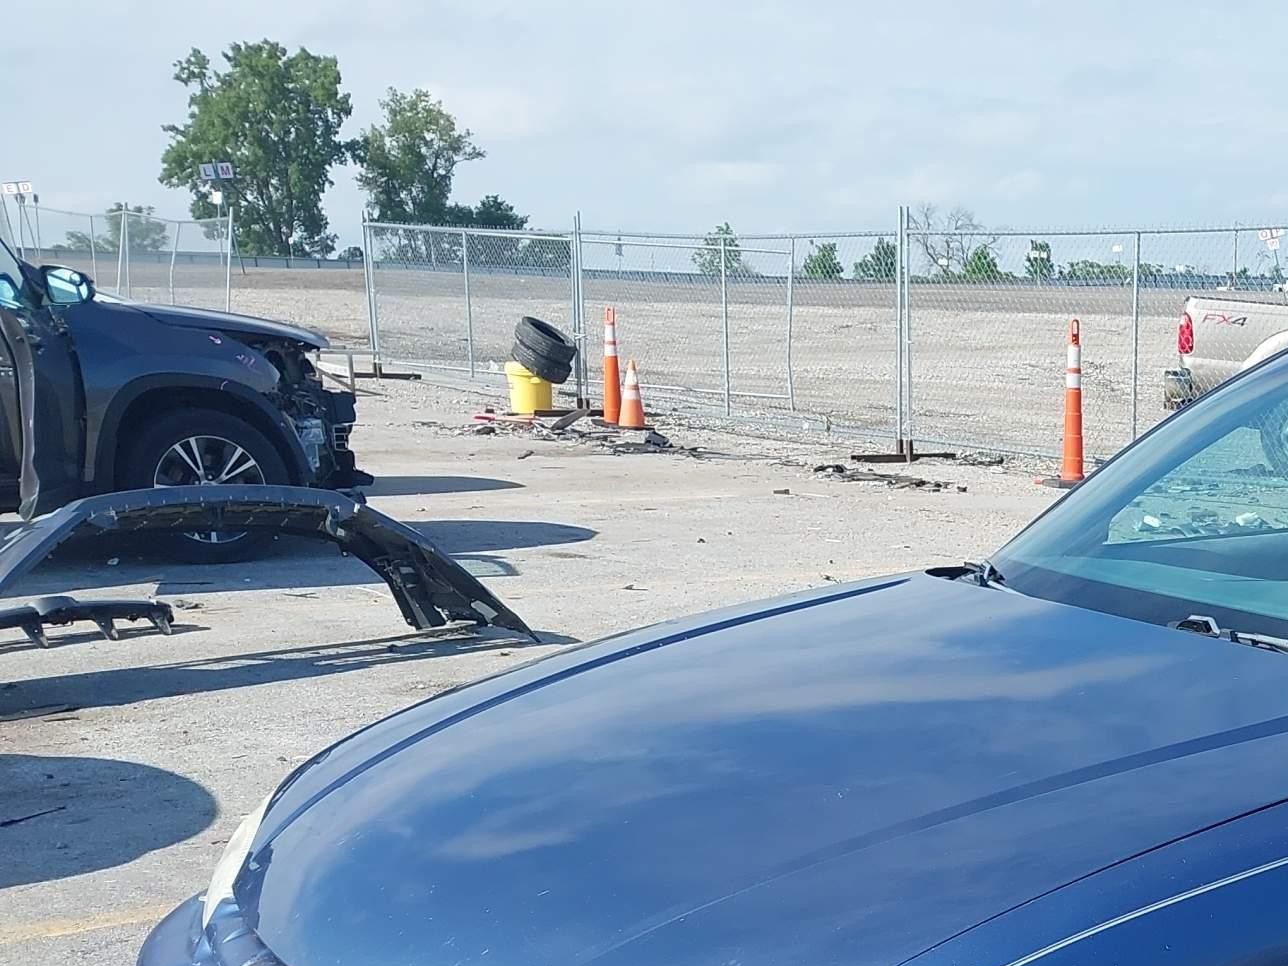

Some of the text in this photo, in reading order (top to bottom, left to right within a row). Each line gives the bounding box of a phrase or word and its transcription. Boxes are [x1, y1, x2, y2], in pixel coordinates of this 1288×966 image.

[203, 165, 231, 177] L M
[7, 183, 30, 193] E D
[1202, 313, 1248, 326] FX4
